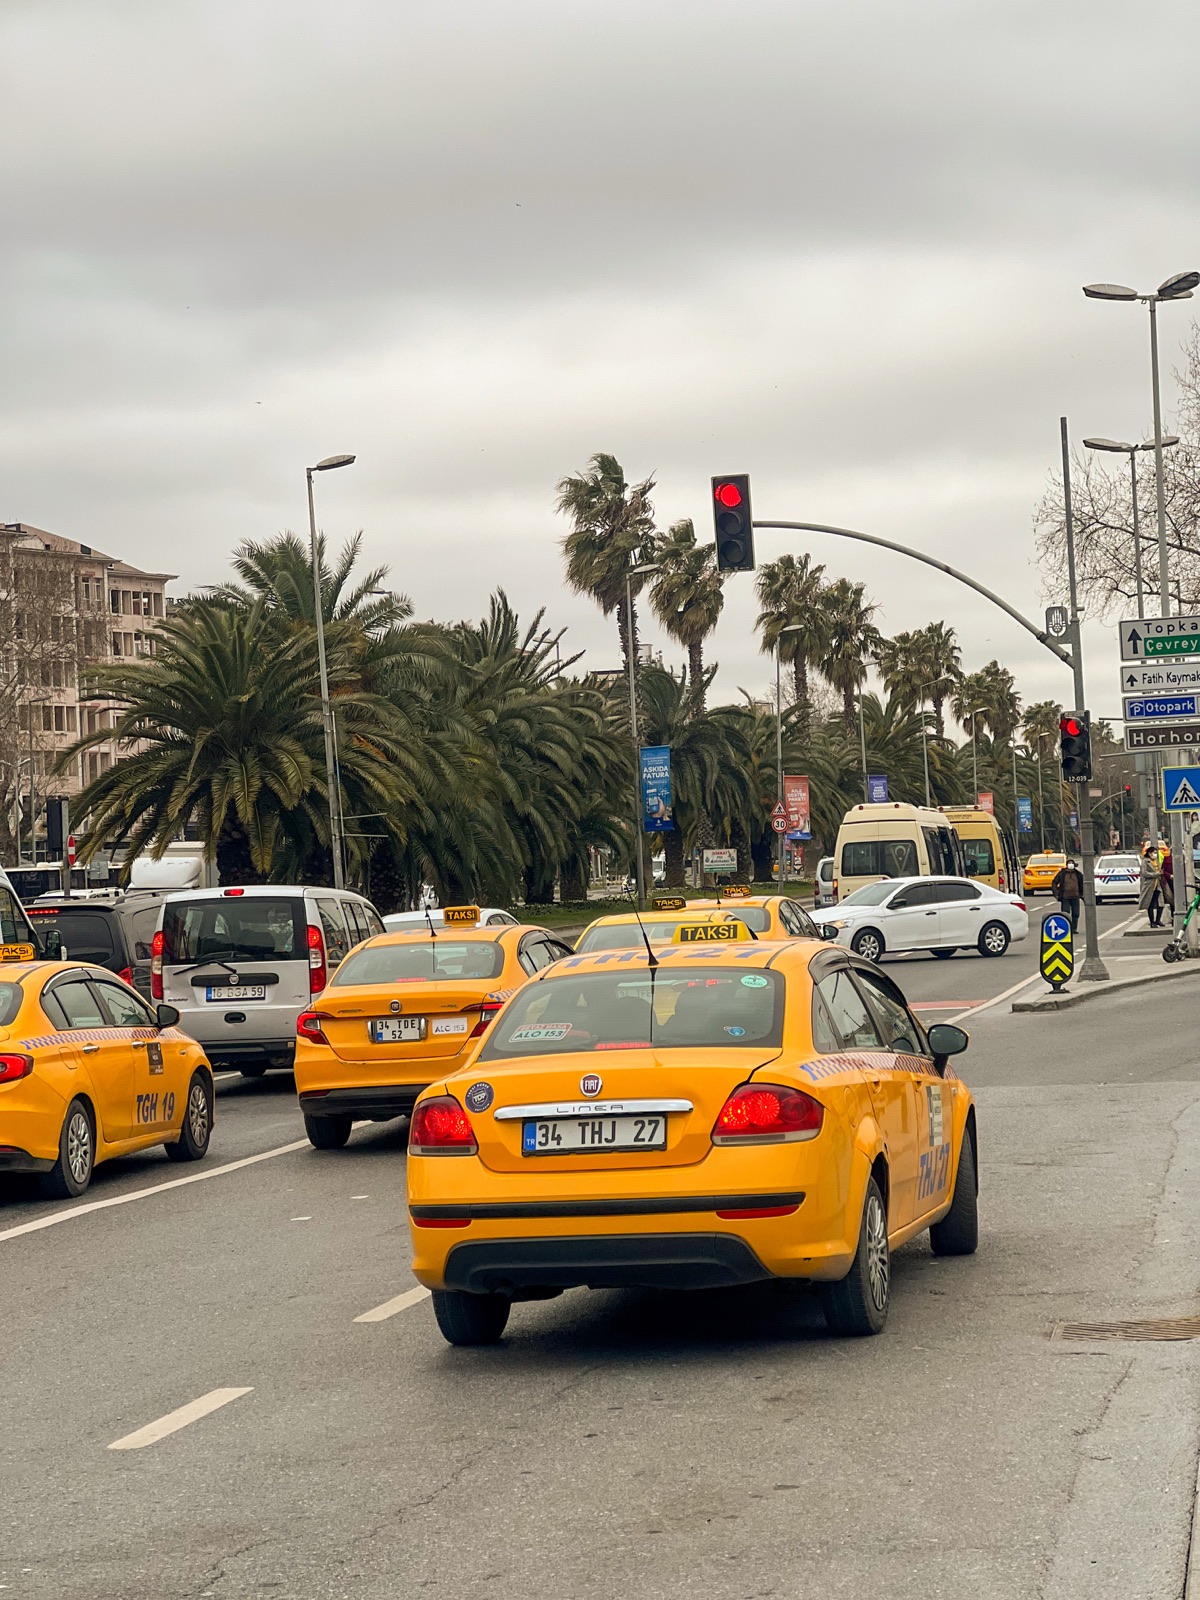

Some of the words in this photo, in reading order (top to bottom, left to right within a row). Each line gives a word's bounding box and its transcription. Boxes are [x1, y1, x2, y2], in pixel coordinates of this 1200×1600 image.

[1144, 620, 1198, 635] Topka
[1146, 639, 1198, 652] Çevrey
[1142, 672, 1163, 684] Fatih
[1145, 700, 1194, 714] Otopark
[564, 949, 678, 968] THJ
[683, 948, 775, 959] 27
[213, 988, 222, 998] 16
[251, 987, 263, 996] 59
[378, 1021, 389, 1030] 34
[391, 1030, 403, 1040] 52
[514, 1031, 541, 1039] ALO
[584, 1079, 598, 1091] FIAT
[136, 1092, 159, 1123] TGH
[162, 1092, 175, 1120] 19
[556, 1104, 624, 1113] LINEA
[526, 1138, 535, 1146] TR
[538, 1123, 562, 1147] 34
[577, 1120, 617, 1145] THJ
[633, 1119, 660, 1143] 27
[918, 1148, 938, 1200] THJ
